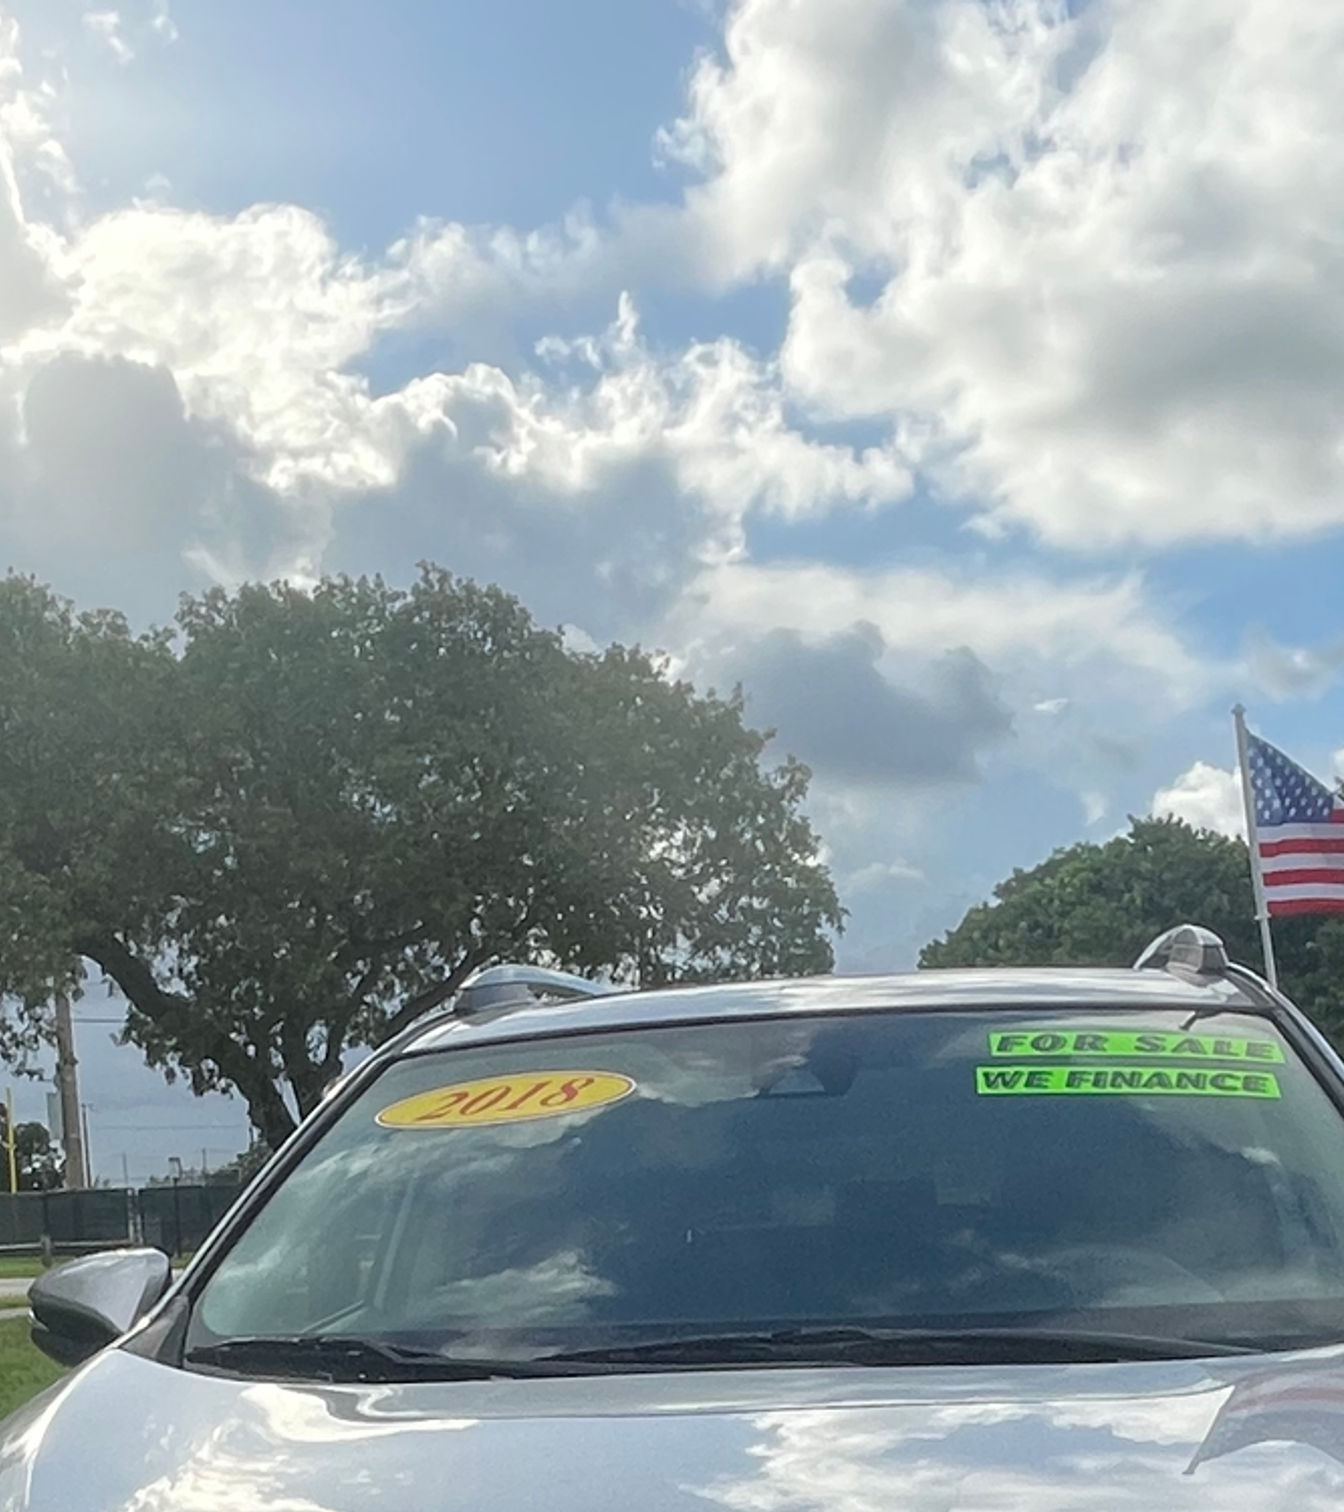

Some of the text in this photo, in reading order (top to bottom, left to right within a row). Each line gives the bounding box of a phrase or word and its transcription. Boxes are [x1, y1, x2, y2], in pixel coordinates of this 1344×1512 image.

[995, 1033, 1276, 1060] FOR SALE
[982, 1070, 1270, 1093] WE FINANCE
[415, 1077, 595, 1122] 2018
